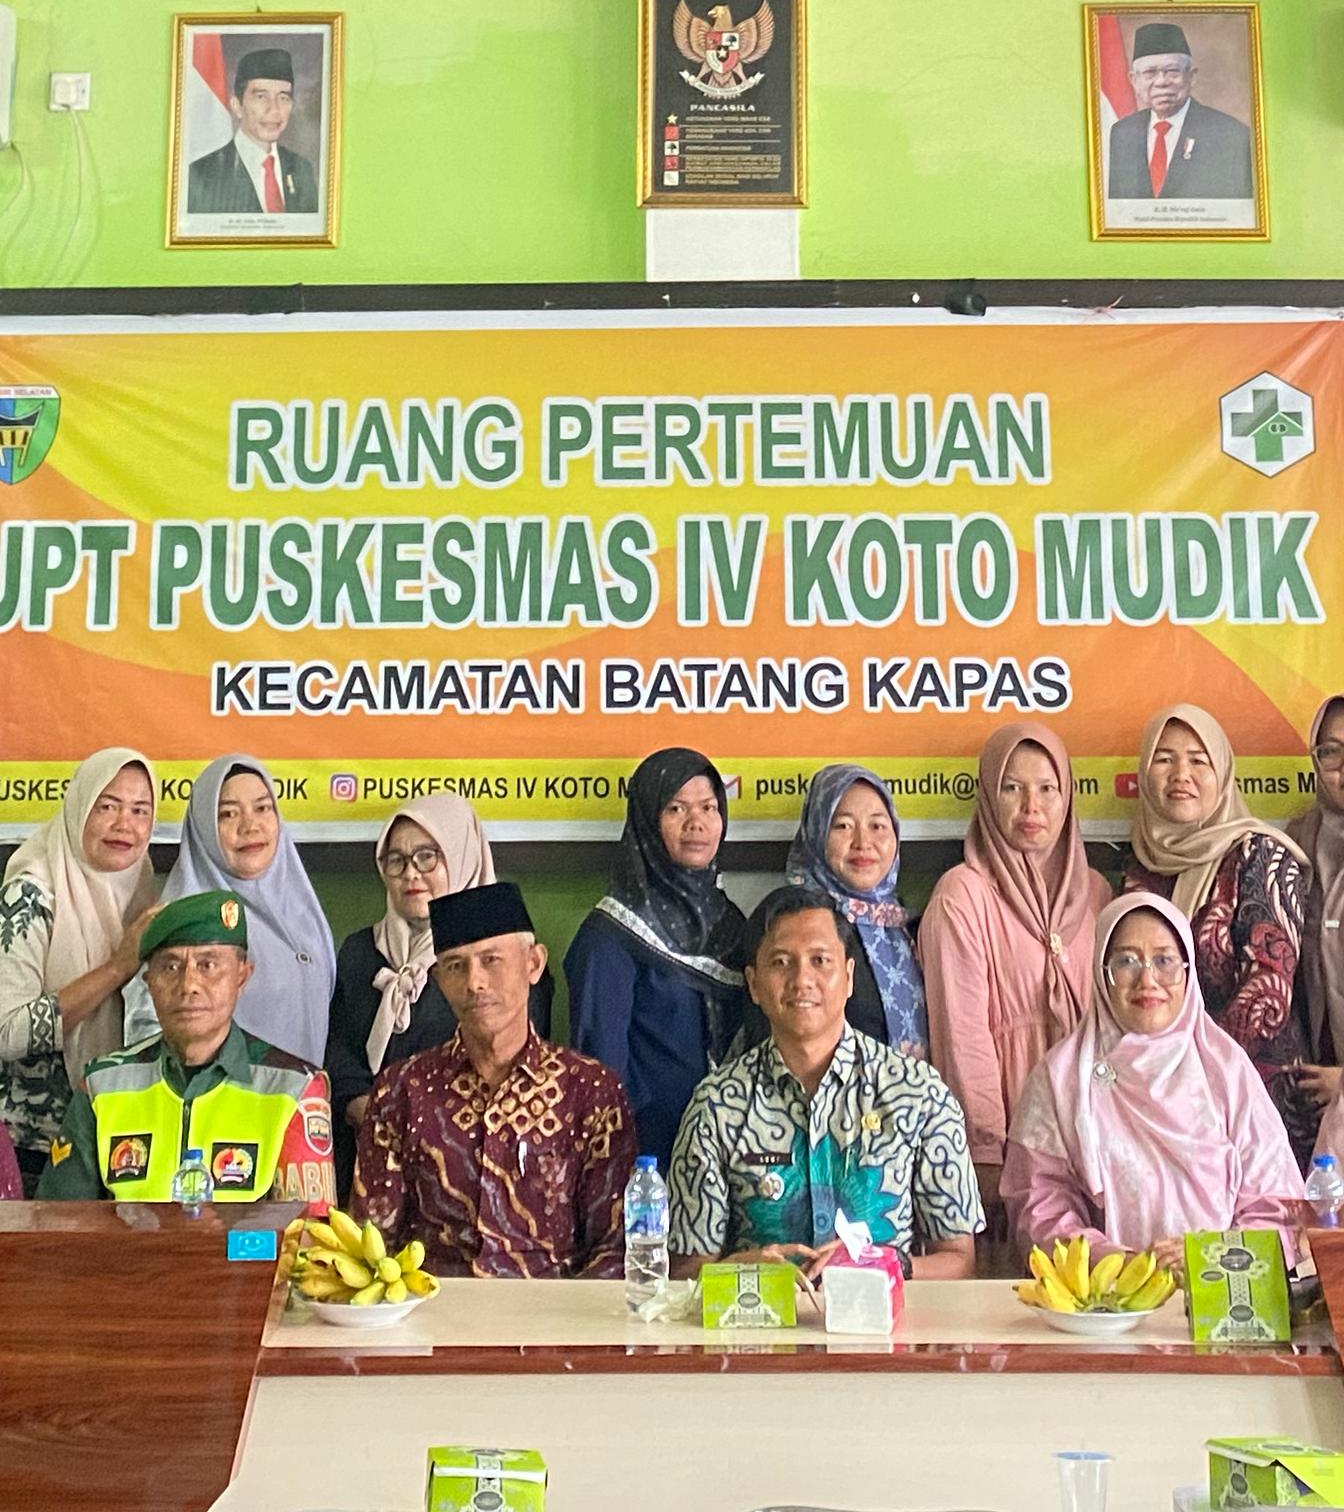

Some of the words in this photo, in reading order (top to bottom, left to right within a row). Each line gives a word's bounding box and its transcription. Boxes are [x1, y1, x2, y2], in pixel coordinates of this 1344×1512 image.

[689, 103, 756, 112] PANCASILA
[232, 402, 521, 486] RUANG
[546, 397, 1051, 485] PERTEMUAN
[152, 516, 657, 628] PUSKESMAS
[679, 516, 767, 625] IV
[786, 513, 1019, 626] KOTO
[1038, 512, 1323, 624] MUDIK
[212, 662, 583, 715] KECAMATAN
[601, 659, 848, 713] BATANG
[864, 659, 1071, 711] KAPAS
[160, 777, 191, 802] KO
[276, 777, 309, 802] DIK
[362, 775, 510, 801] PUSKESMAS
[514, 775, 537, 800] IV
[543, 775, 611, 800] KOTO
